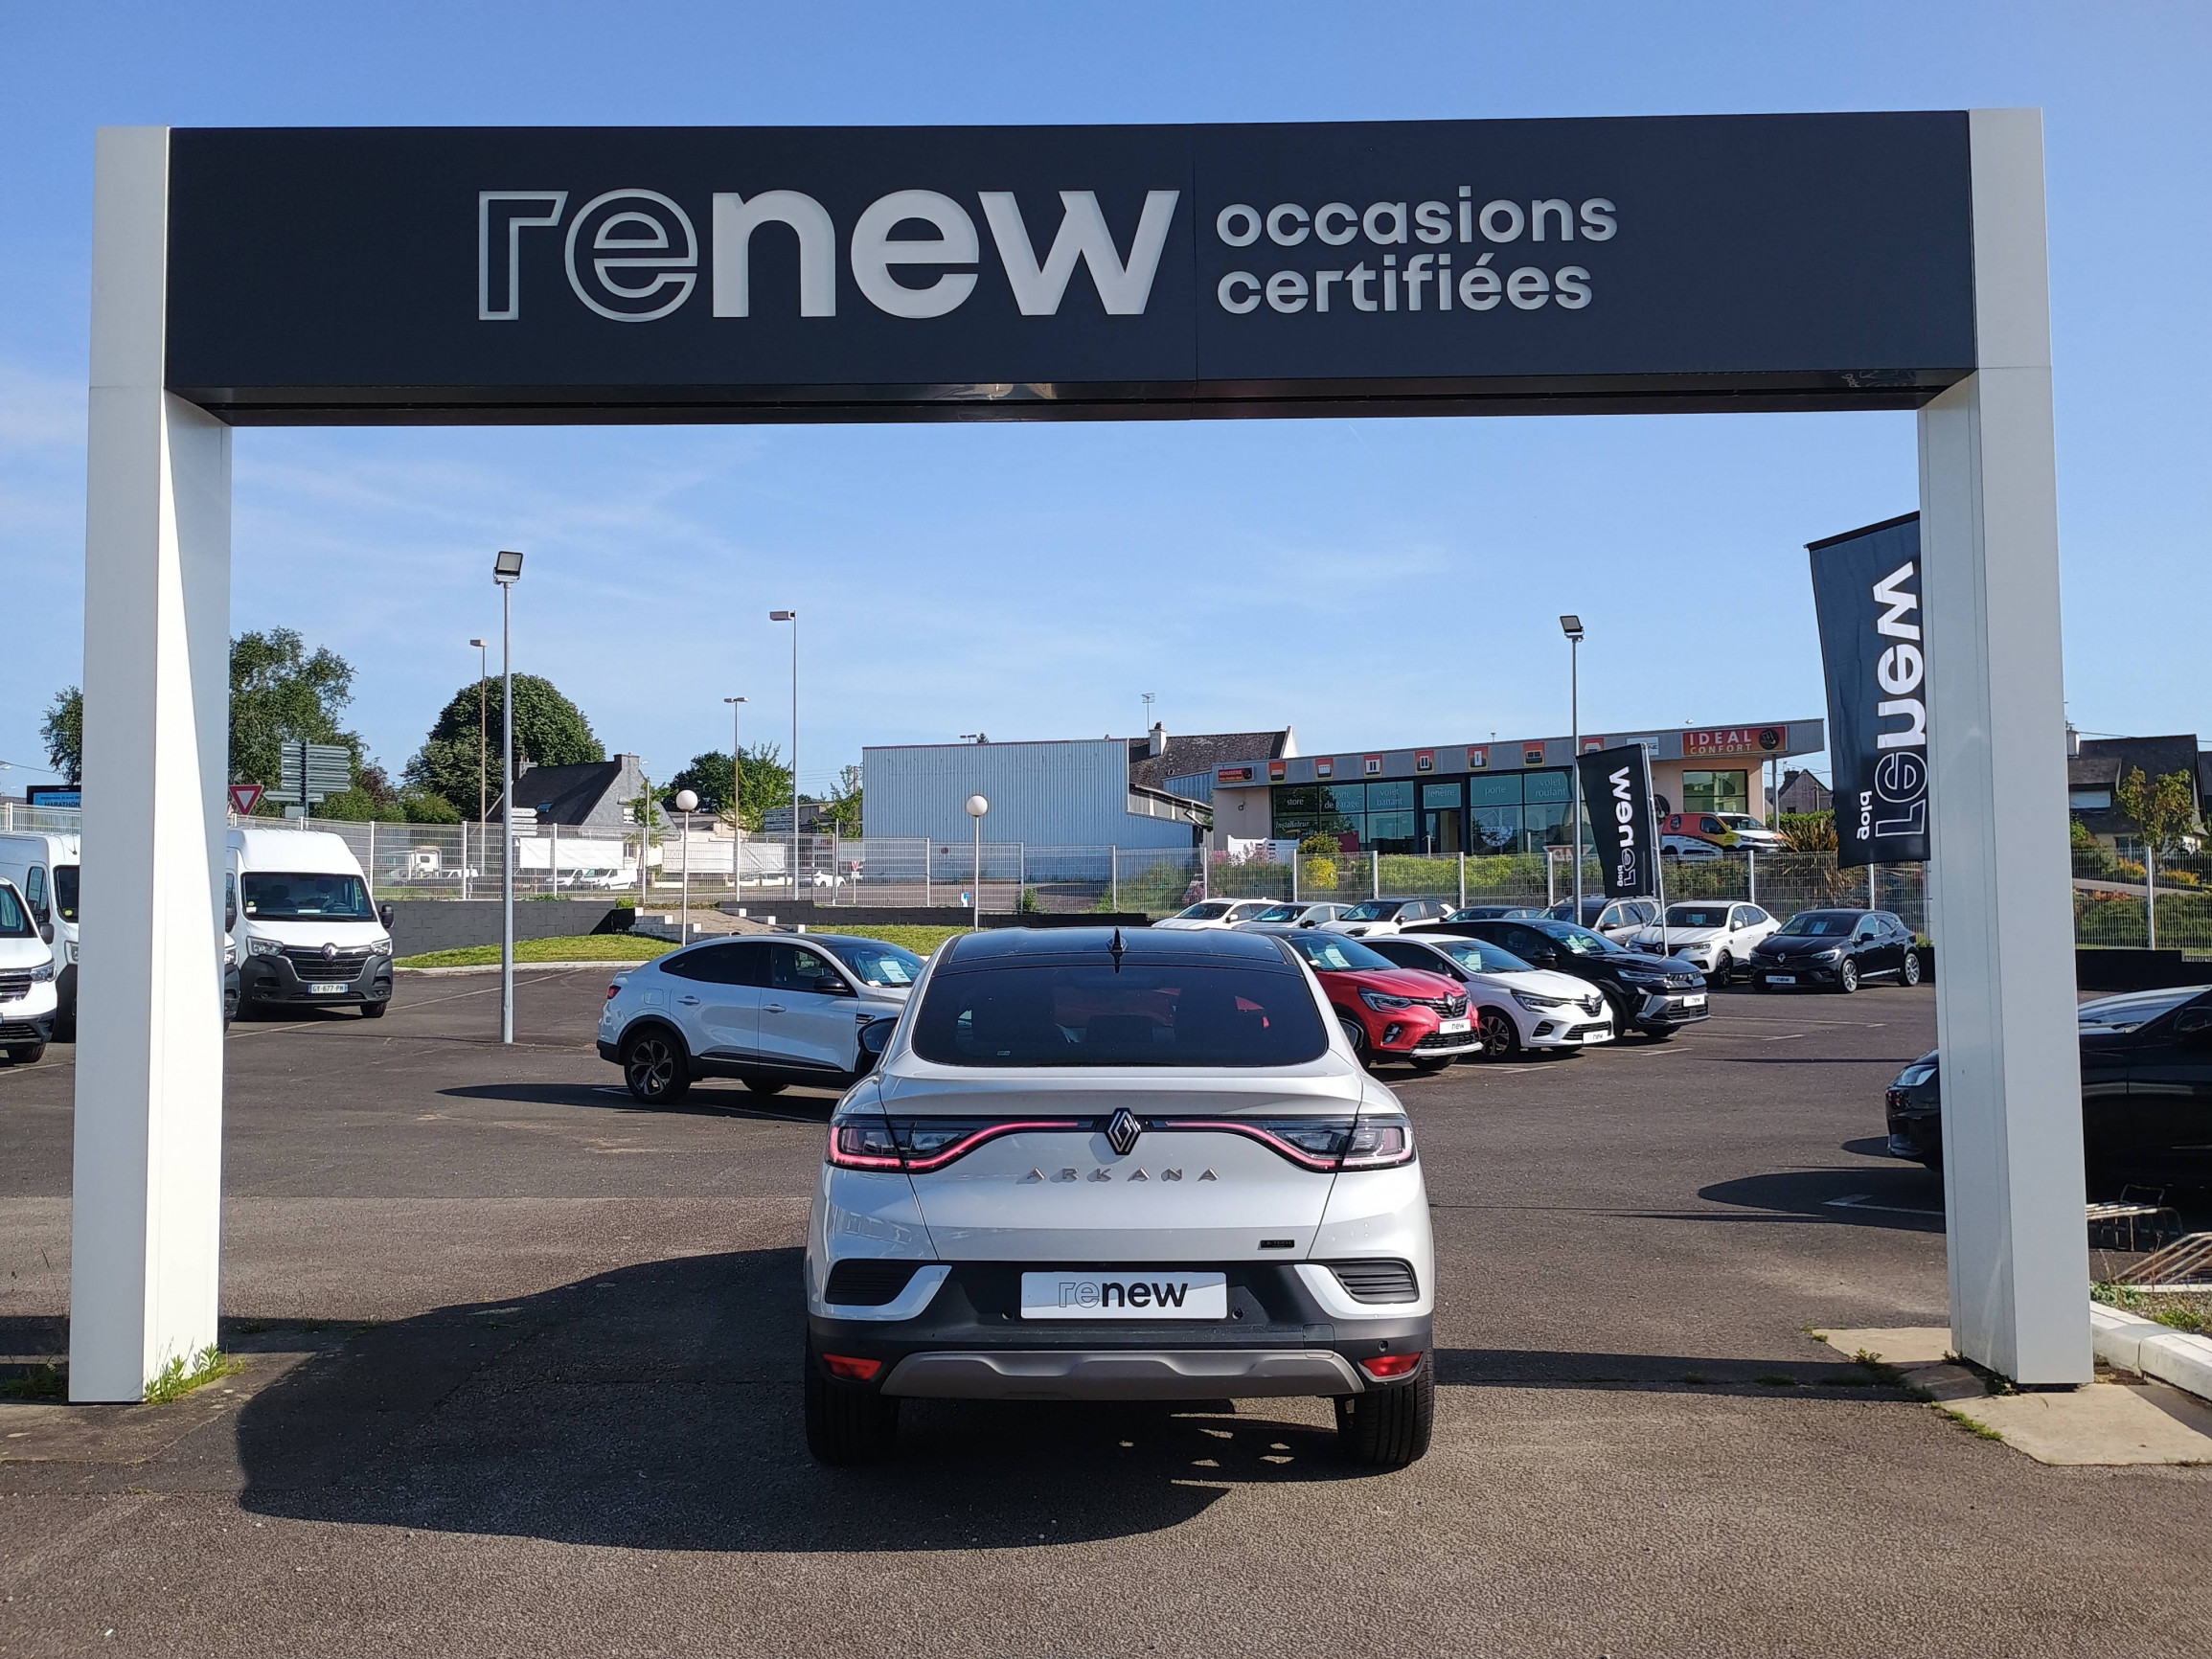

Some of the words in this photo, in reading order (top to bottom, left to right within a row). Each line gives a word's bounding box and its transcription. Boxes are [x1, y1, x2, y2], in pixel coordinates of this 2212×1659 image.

[1216, 185, 1618, 247] occasions
[478, 188, 1180, 323] renew
[1217, 252, 1593, 314] certifiées
[1689, 730, 1752, 746] IDEAL
[1690, 743, 1752, 755] CONFORT
[1539, 778, 1562, 787] volet
[1380, 787, 1400, 797] volet
[1485, 784, 1507, 796] porte
[1535, 786, 1566, 797] roulant
[1286, 798, 1304, 807] store
[1335, 800, 1360, 810] garage
[1376, 797, 1403, 807] battant
[1026, 1167, 1220, 1182] ARKANA
[1058, 1282, 1189, 1308] renew
